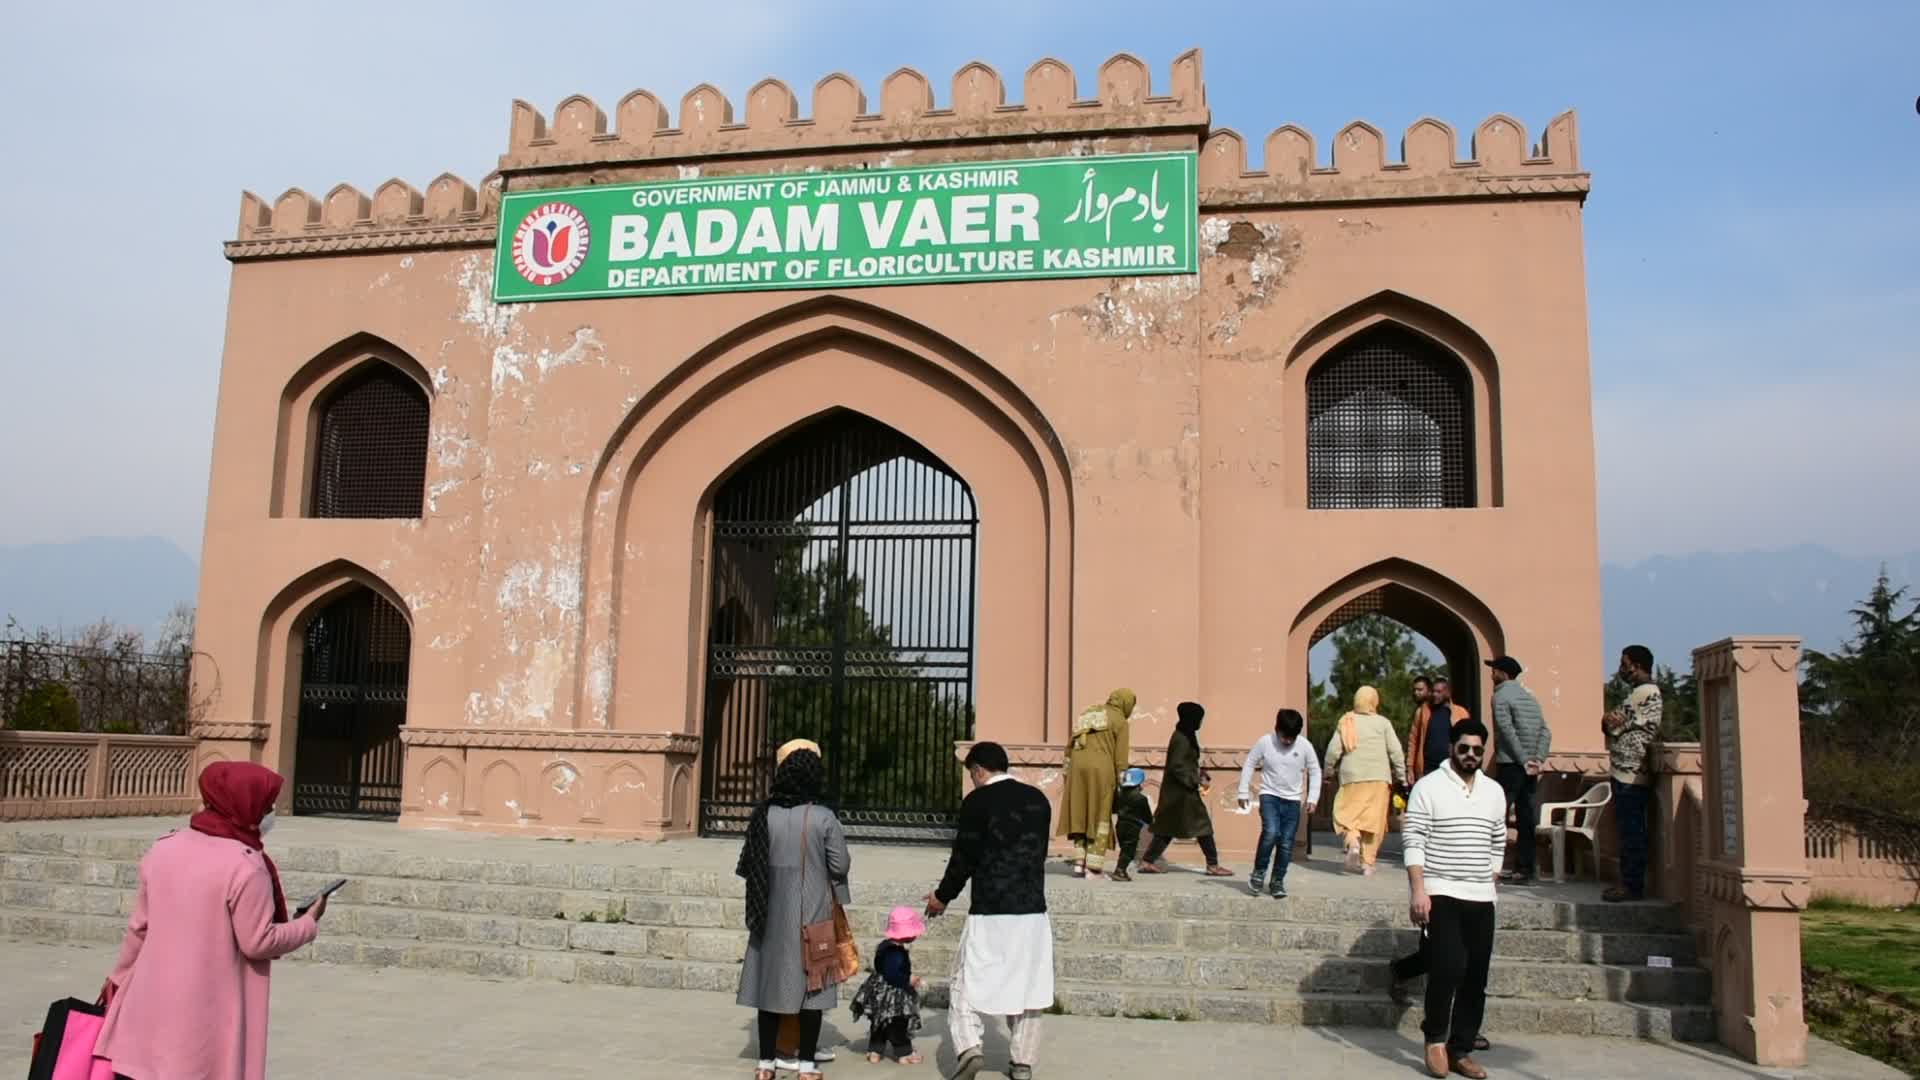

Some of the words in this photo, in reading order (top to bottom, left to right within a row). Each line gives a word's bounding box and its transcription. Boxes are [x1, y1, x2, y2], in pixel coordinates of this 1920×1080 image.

[632, 184, 775, 208] GOVERNMENT
[780, 181, 809, 200] OF
[814, 176, 891, 197] JAMMU
[897, 175, 913, 193] &
[919, 169, 1019, 191] KASHMIR
[608, 204, 840, 262] BADAM
[858, 192, 1041, 249] VAER
[607, 261, 777, 289] DEPARTMENT
[785, 259, 820, 280] OF
[828, 250, 1034, 279] FLORICULTURE
[1043, 245, 1176, 269] KASHMIR
